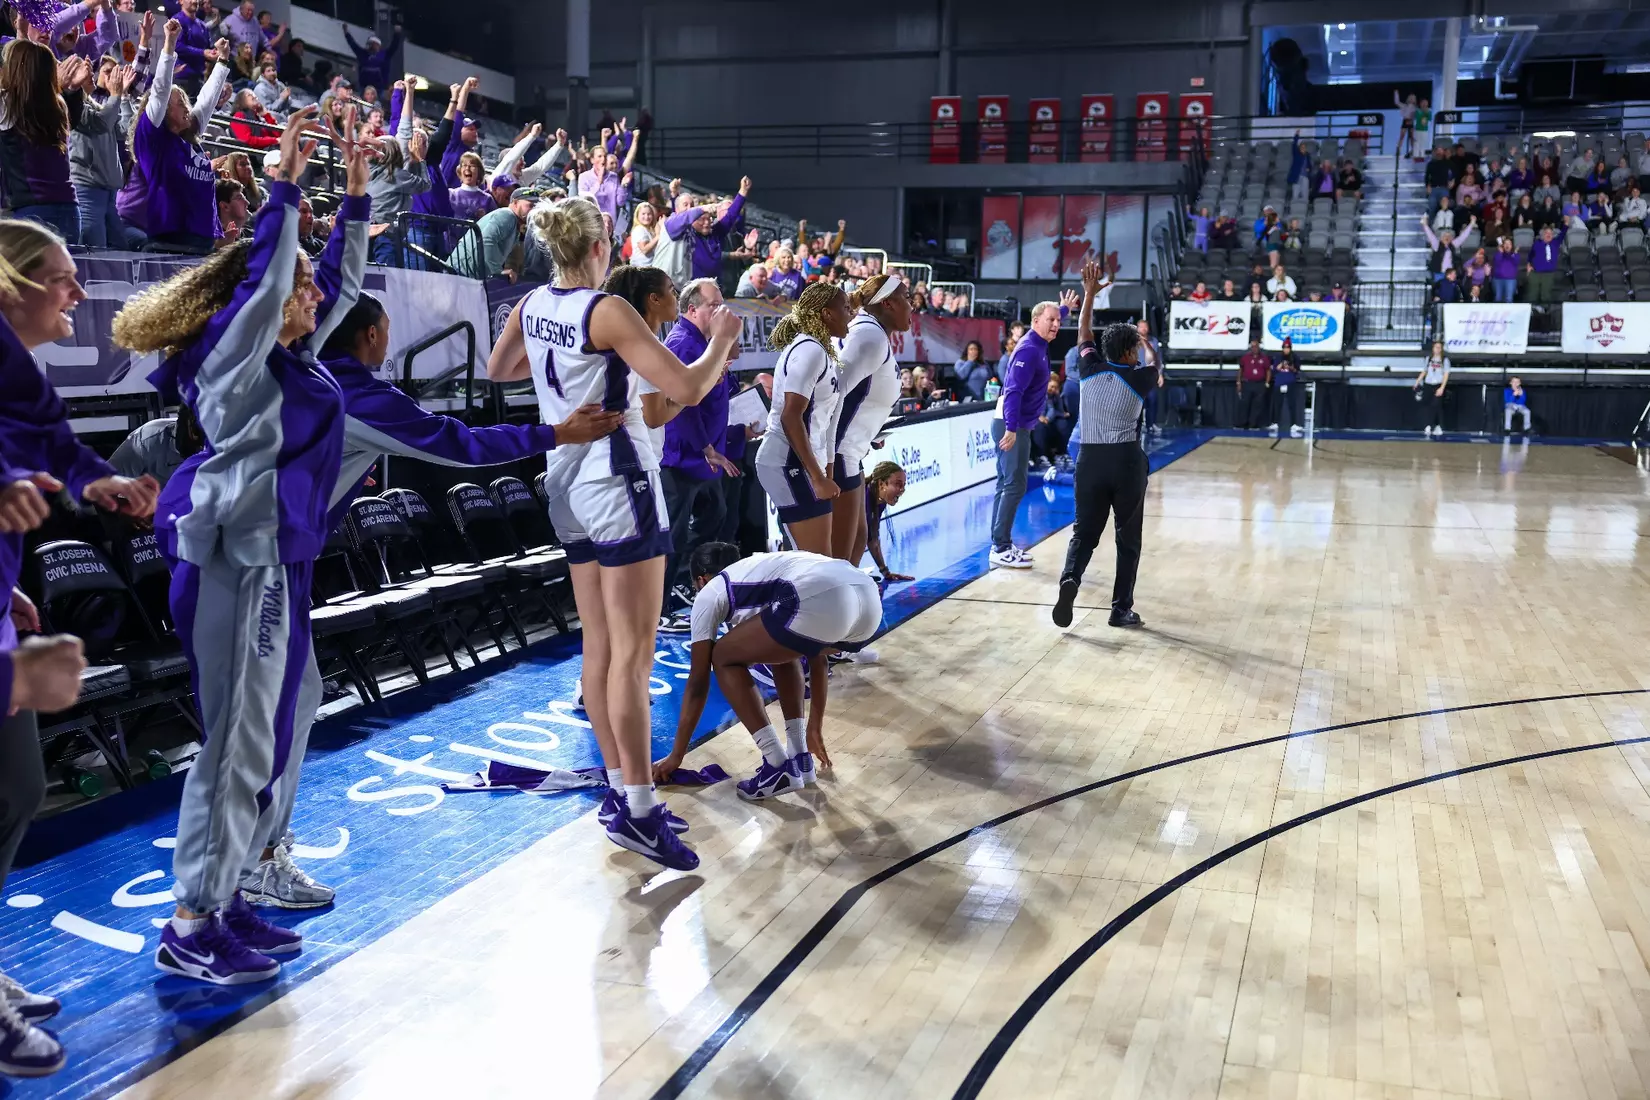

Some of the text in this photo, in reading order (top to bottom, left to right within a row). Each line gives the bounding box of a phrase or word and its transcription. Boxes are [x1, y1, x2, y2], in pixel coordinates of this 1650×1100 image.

[545, 348, 566, 400] 4
[367, 503, 392, 513] JOSEPH
[376, 514, 401, 524] ARENA
[43, 548, 96, 565] ST. JOSEPH
[133, 550, 155, 564] CIVIC
[45, 562, 108, 582] CIVIC ARENA
[258, 580, 284, 657] Wildcats
